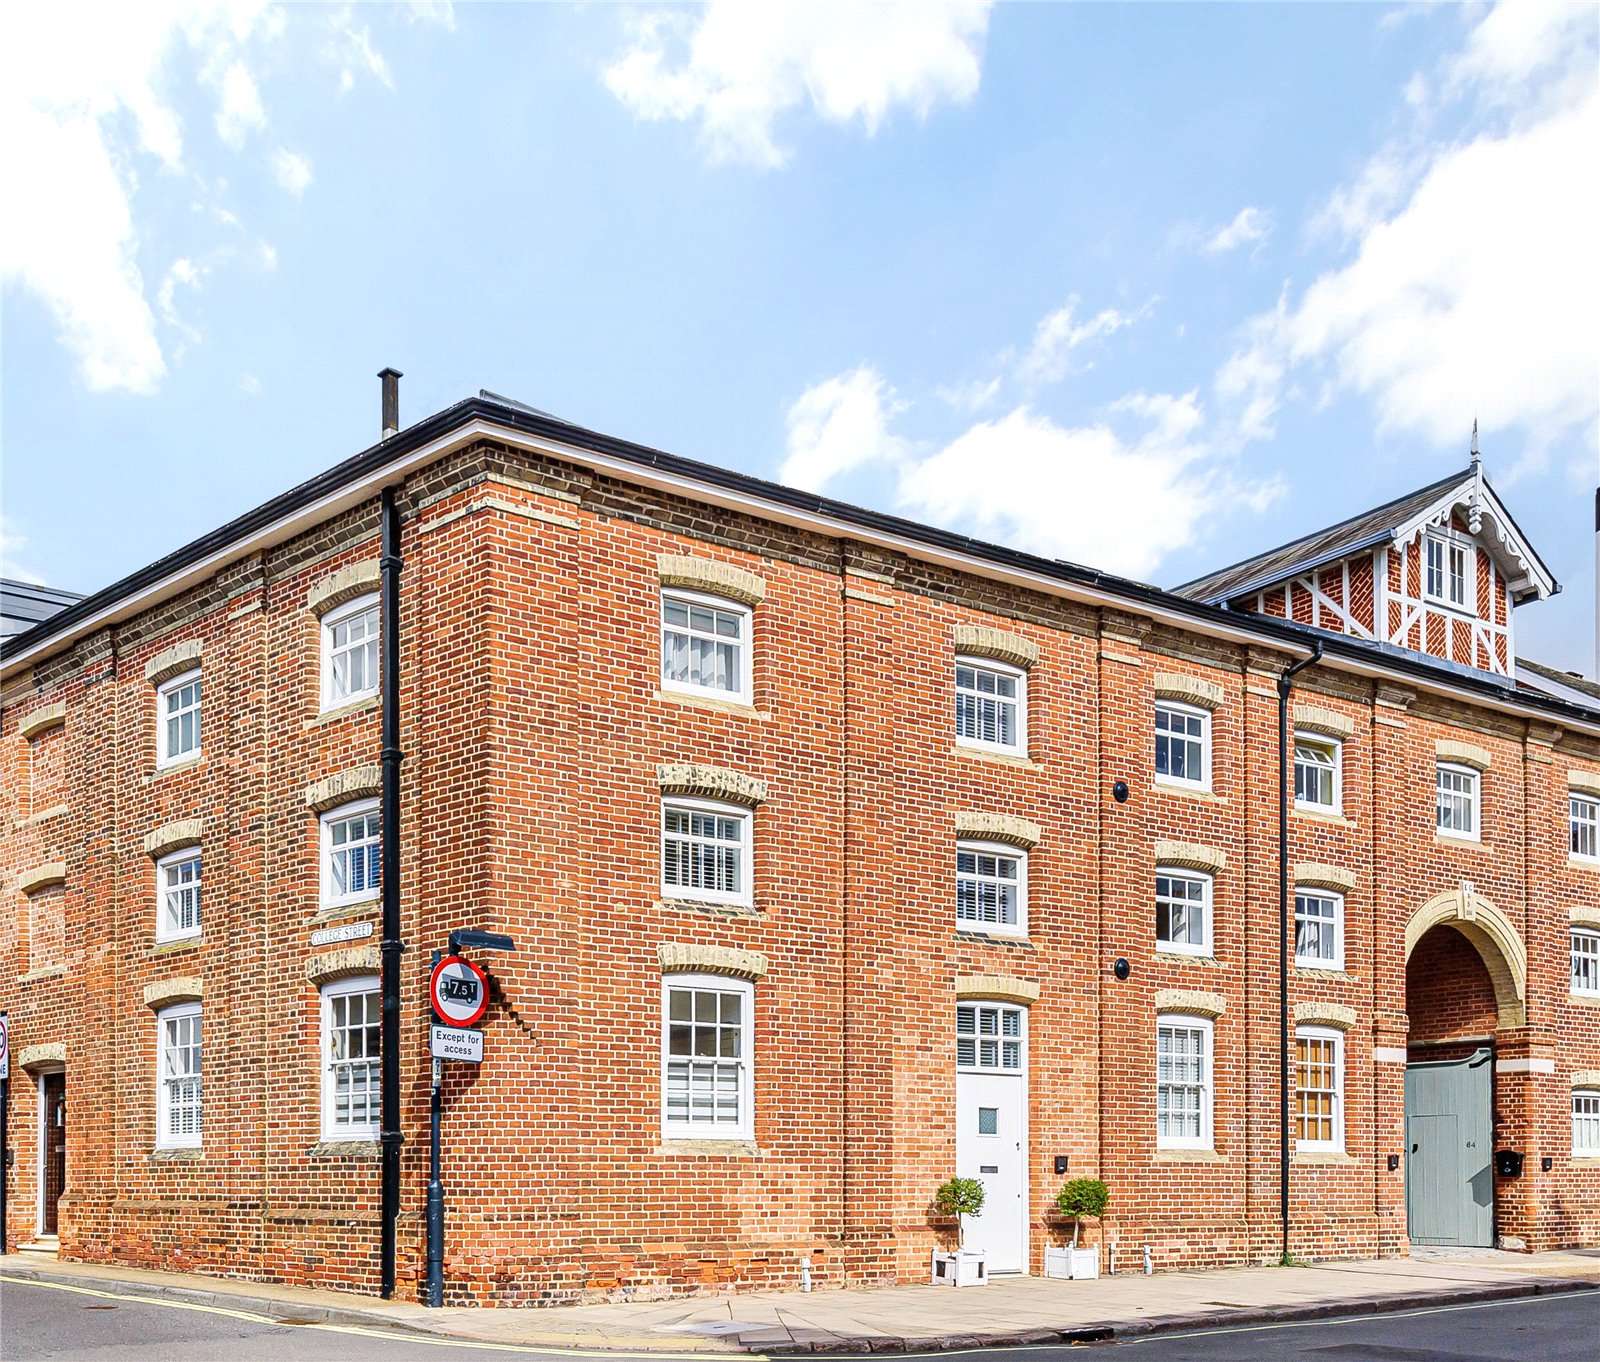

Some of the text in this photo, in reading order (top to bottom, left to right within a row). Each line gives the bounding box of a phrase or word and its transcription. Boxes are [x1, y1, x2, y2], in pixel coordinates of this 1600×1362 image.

[312, 923, 371, 944] COLLEGE STREET
[436, 1030, 480, 1045] Except for
[444, 1044, 472, 1055] access
